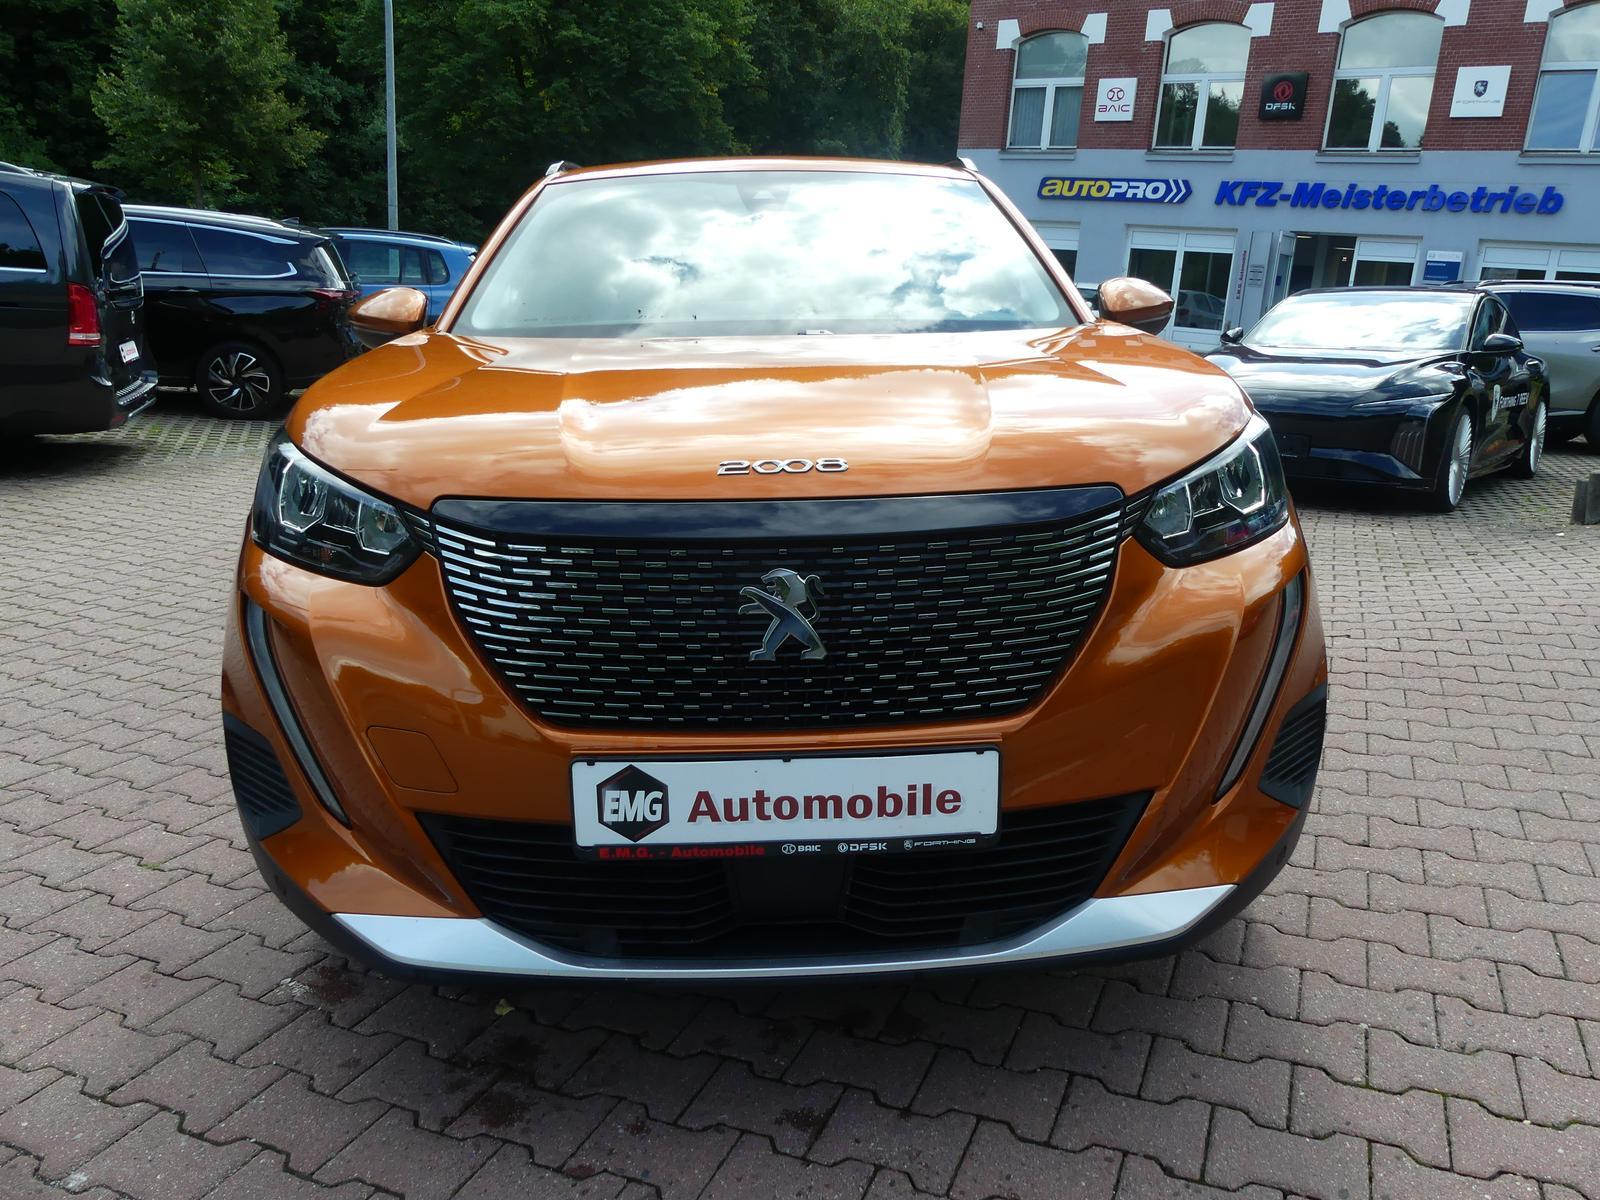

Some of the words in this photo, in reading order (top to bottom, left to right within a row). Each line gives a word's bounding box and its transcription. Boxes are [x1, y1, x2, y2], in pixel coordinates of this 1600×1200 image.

[1098, 104, 1131, 112] BAIC
[1264, 102, 1296, 112] DFSK
[1214, 180, 1565, 215] KFZ-Meisterbetrieb
[717, 457, 849, 476] 2008
[602, 790, 664, 823] EMG
[687, 783, 962, 823] Automobile
[849, 842, 888, 852] DFSK
[913, 838, 977, 848] FORTHING
[598, 847, 654, 860] E.M.G.
[671, 845, 766, 859] Automobile
[797, 844, 822, 853] BAIC
